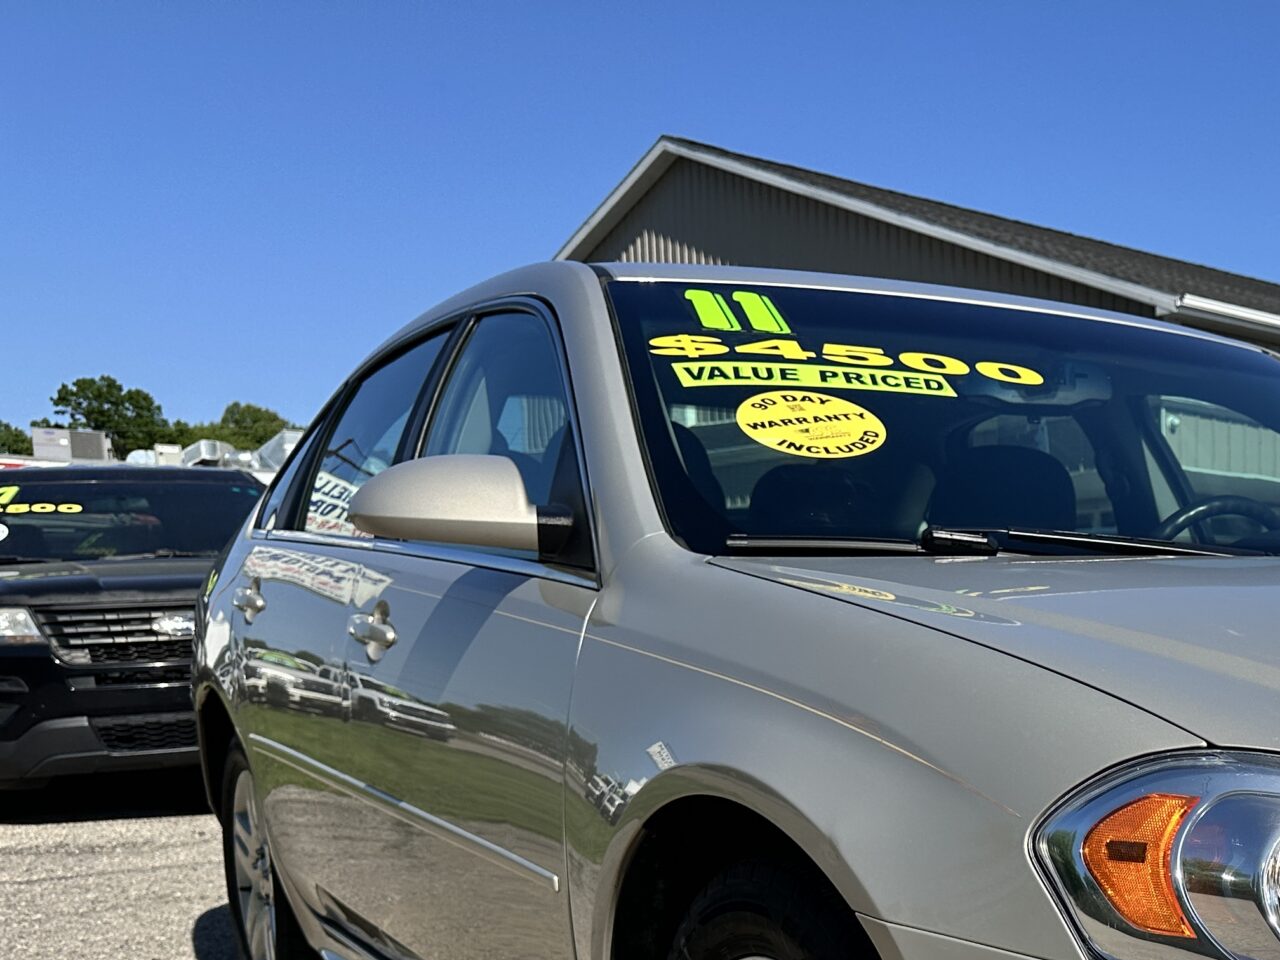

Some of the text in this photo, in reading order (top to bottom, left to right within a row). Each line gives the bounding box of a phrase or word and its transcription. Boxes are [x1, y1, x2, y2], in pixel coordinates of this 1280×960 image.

[685, 289, 791, 334] 11
[649, 334, 1045, 386] $4500
[682, 365, 944, 391] VALUE PRICED
[751, 397, 777, 411] 90
[780, 394, 832, 405] DAY
[746, 412, 866, 430] WARRANTY
[777, 430, 879, 454] INCLUDED
[0, 503, 83, 514] 500
